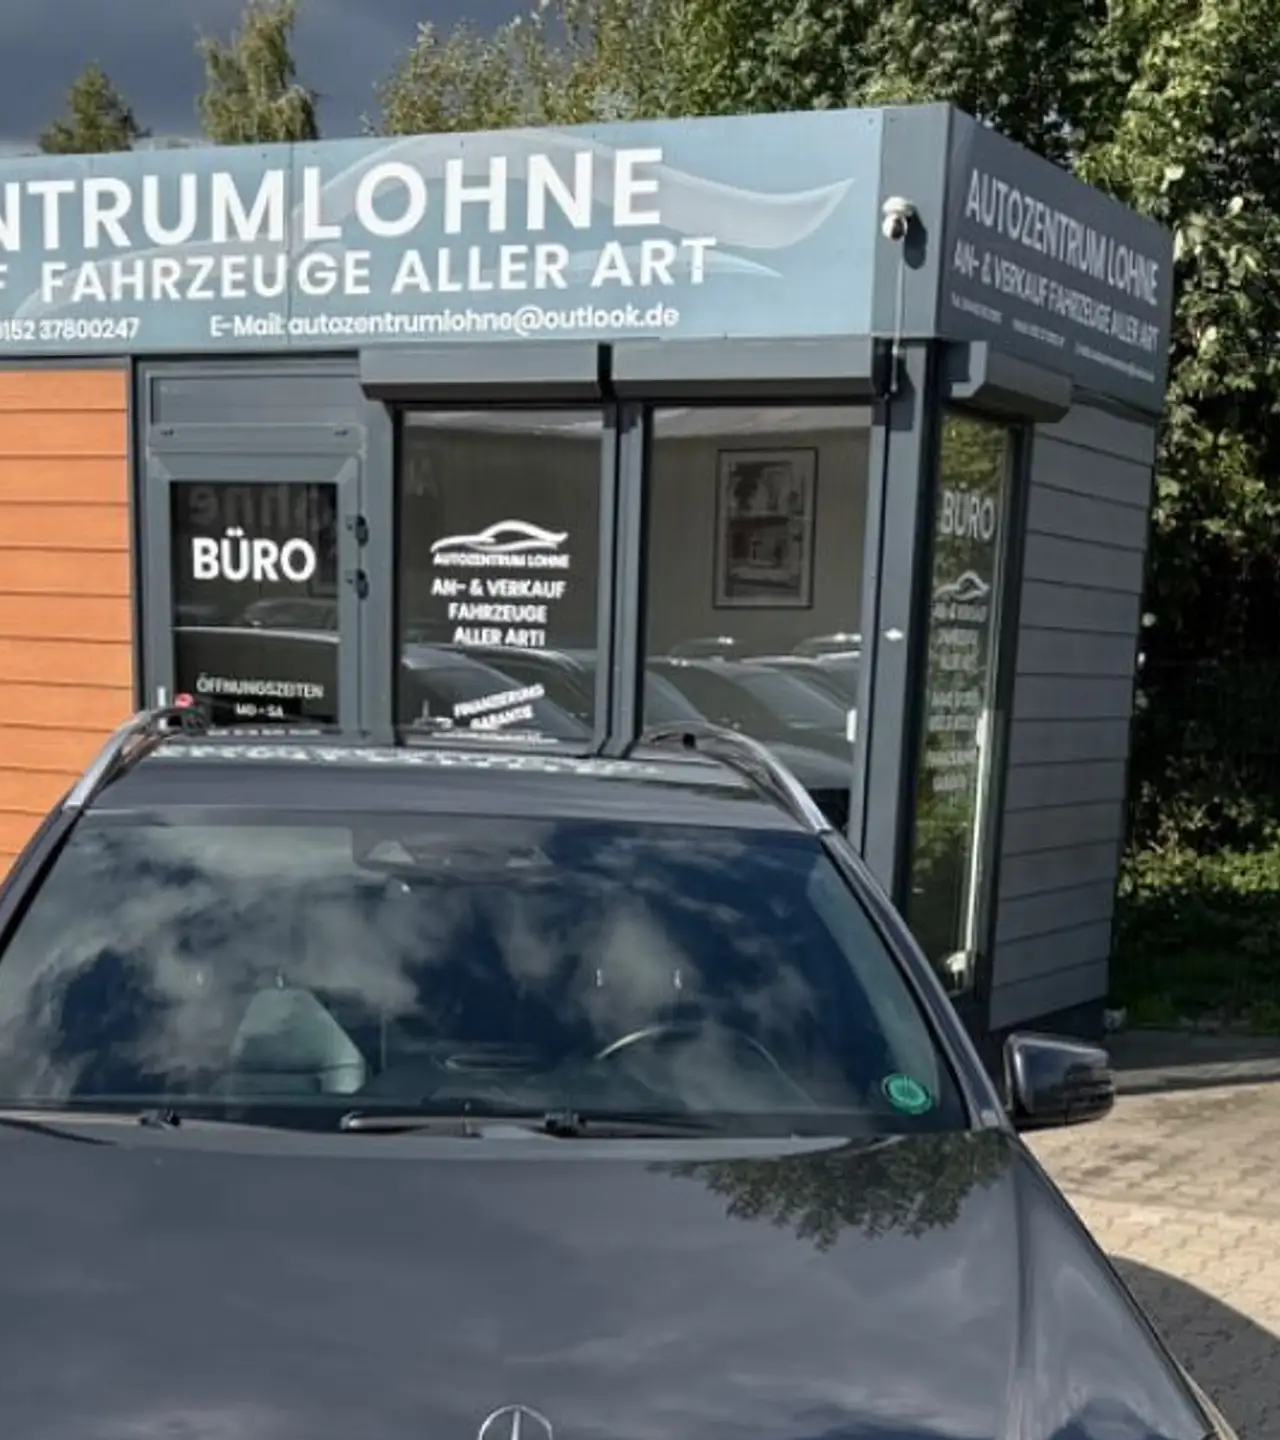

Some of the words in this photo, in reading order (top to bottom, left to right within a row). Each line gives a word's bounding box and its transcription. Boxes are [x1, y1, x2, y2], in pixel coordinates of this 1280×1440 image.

[965, 168, 1105, 279] AUTOZENTRUM
[1106, 235, 1159, 306] LOHNE
[42, 252, 371, 303] FAHRZEUGE
[391, 241, 570, 293] ALLER
[591, 236, 717, 288] ART
[993, 255, 1047, 310] VERKAUF
[39, 316, 140, 340] 37800247
[940, 482, 995, 541] BÜRO
[192, 525, 317, 582] BÜRO
[433, 552, 526, 567] AUTOZENTRUM
[527, 553, 570, 569] LOHNE
[430, 577, 467, 597] AN-
[468, 578, 484, 597] &
[485, 578, 566, 599] VERKAUF
[448, 602, 548, 623] FAHRZEUGE
[453, 626, 502, 646] ALLER
[196, 671, 325, 699] ÖFFNUNGSZEITEN
